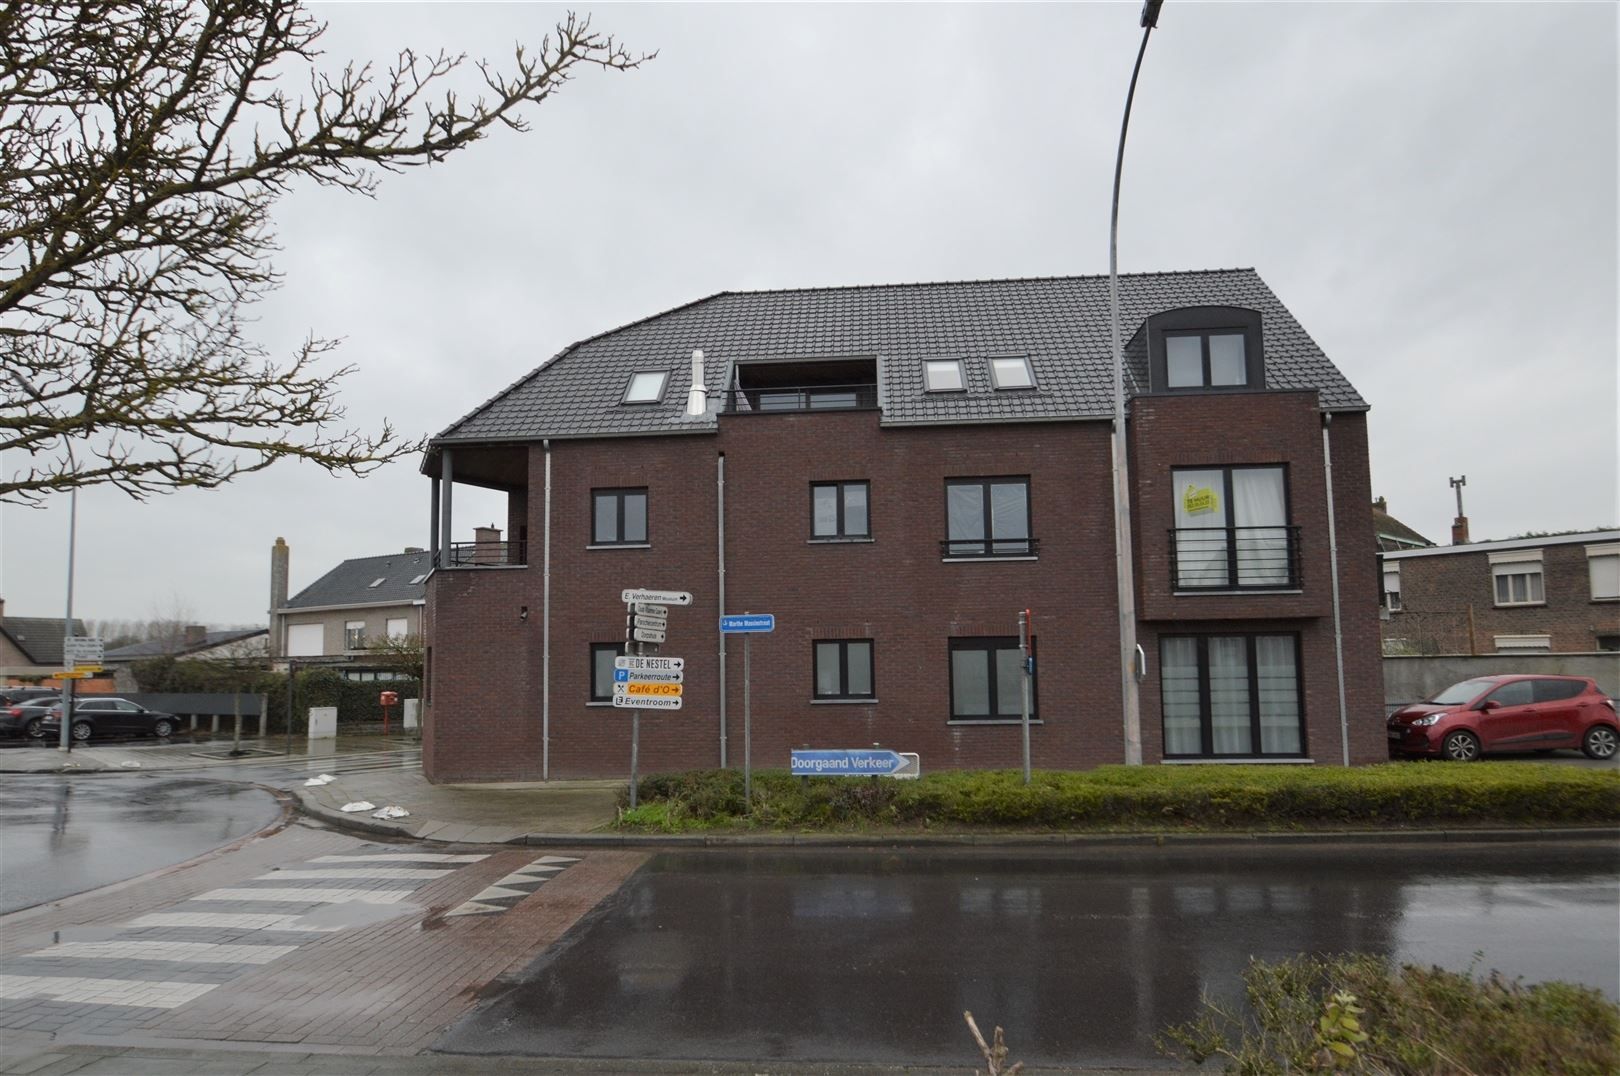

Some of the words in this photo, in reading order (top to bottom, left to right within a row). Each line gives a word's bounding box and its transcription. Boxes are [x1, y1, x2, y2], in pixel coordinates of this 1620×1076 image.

[632, 592, 662, 601] Verhaeren
[635, 658, 644, 669] DE
[646, 659, 671, 669] NESTEL
[629, 672, 672, 681] Parkeerroute
[628, 684, 651, 694] Café
[653, 684, 670, 694] d'O
[624, 697, 671, 706] Eventroom
[791, 756, 849, 771] Doorgaand
[851, 756, 894, 769] Verkeer
